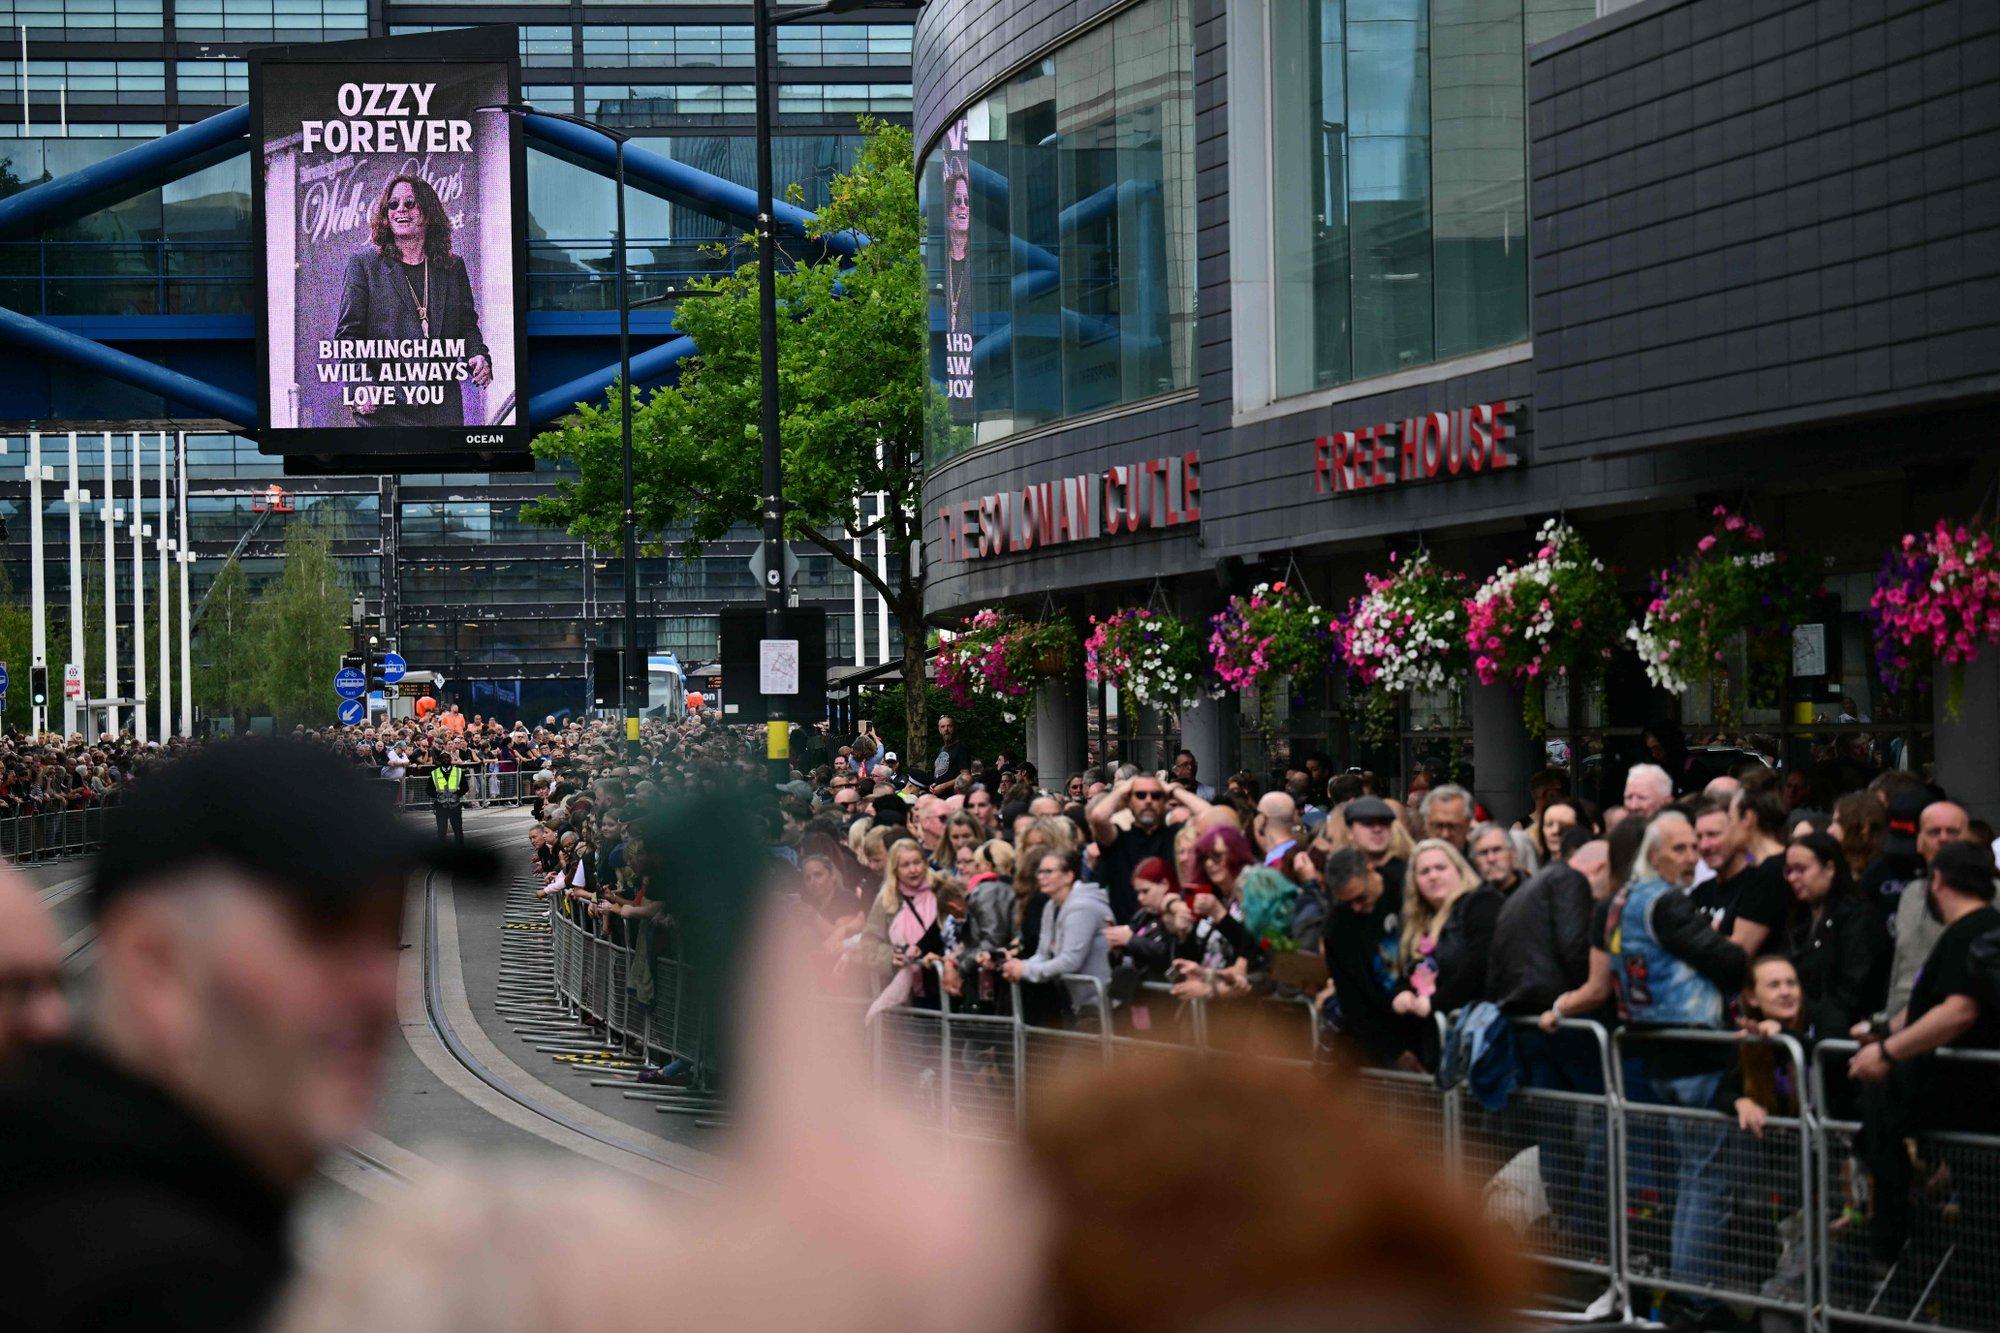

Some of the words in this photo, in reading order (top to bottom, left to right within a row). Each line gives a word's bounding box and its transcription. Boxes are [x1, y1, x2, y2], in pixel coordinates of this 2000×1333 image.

[338, 83, 436, 116] OZZY
[301, 119, 474, 153] FOREVER
[318, 338, 466, 359] BIRMINGHAM
[317, 363, 373, 383] WILL
[379, 362, 469, 382] ALWAYS
[343, 386, 396, 406] LOVE
[402, 385, 445, 405] YOU
[466, 434, 504, 444] OCEAN
[1314, 423, 1396, 495] FREE
[1401, 400, 1517, 481] HOUSE
[939, 500, 979, 564] THE
[1105, 450, 1200, 534] CUTLE
